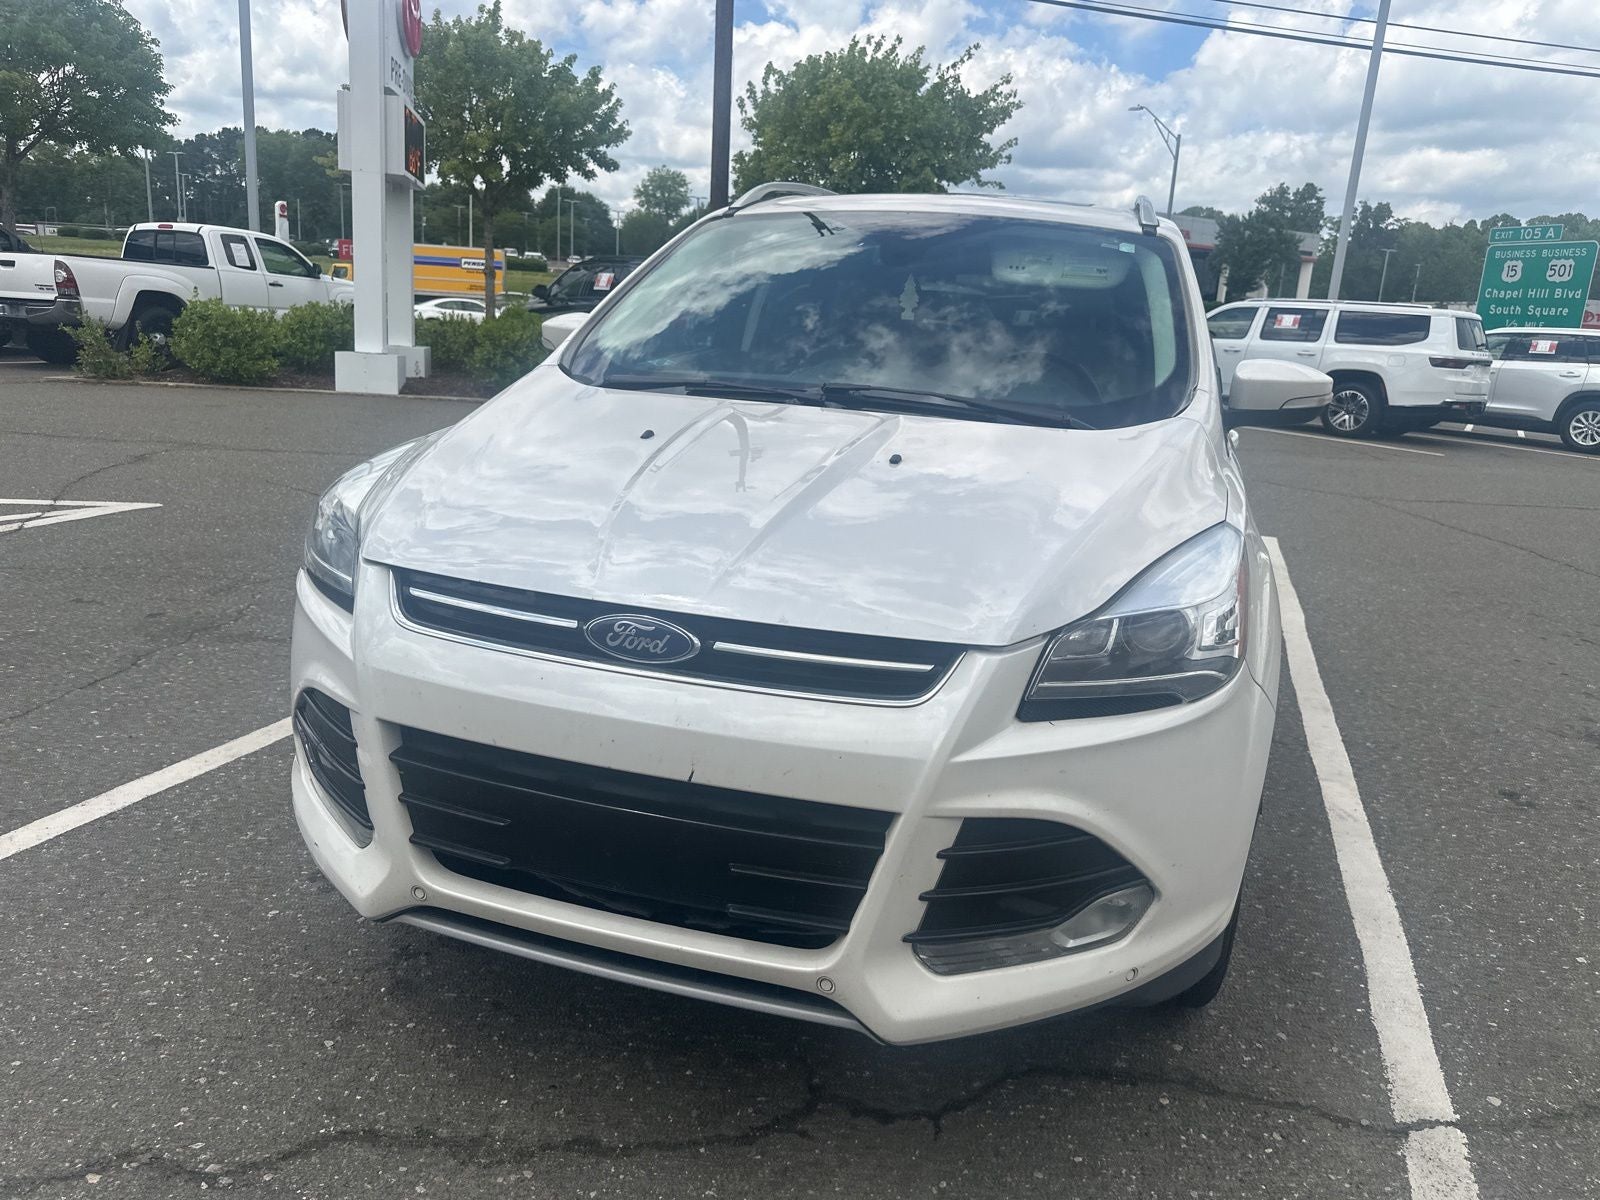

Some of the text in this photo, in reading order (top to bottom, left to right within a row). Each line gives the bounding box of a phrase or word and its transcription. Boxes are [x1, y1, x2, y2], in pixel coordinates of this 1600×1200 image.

[1495, 227, 1555, 240] EXIT 105 A
[1495, 248, 1587, 259] BUSINESS BUSINESS
[1506, 264, 1573, 278] 15 501
[1485, 288, 1582, 301] Chapel Hill Blvd
[1489, 304, 1569, 317] South Square
[606, 620, 671, 654] Ford
